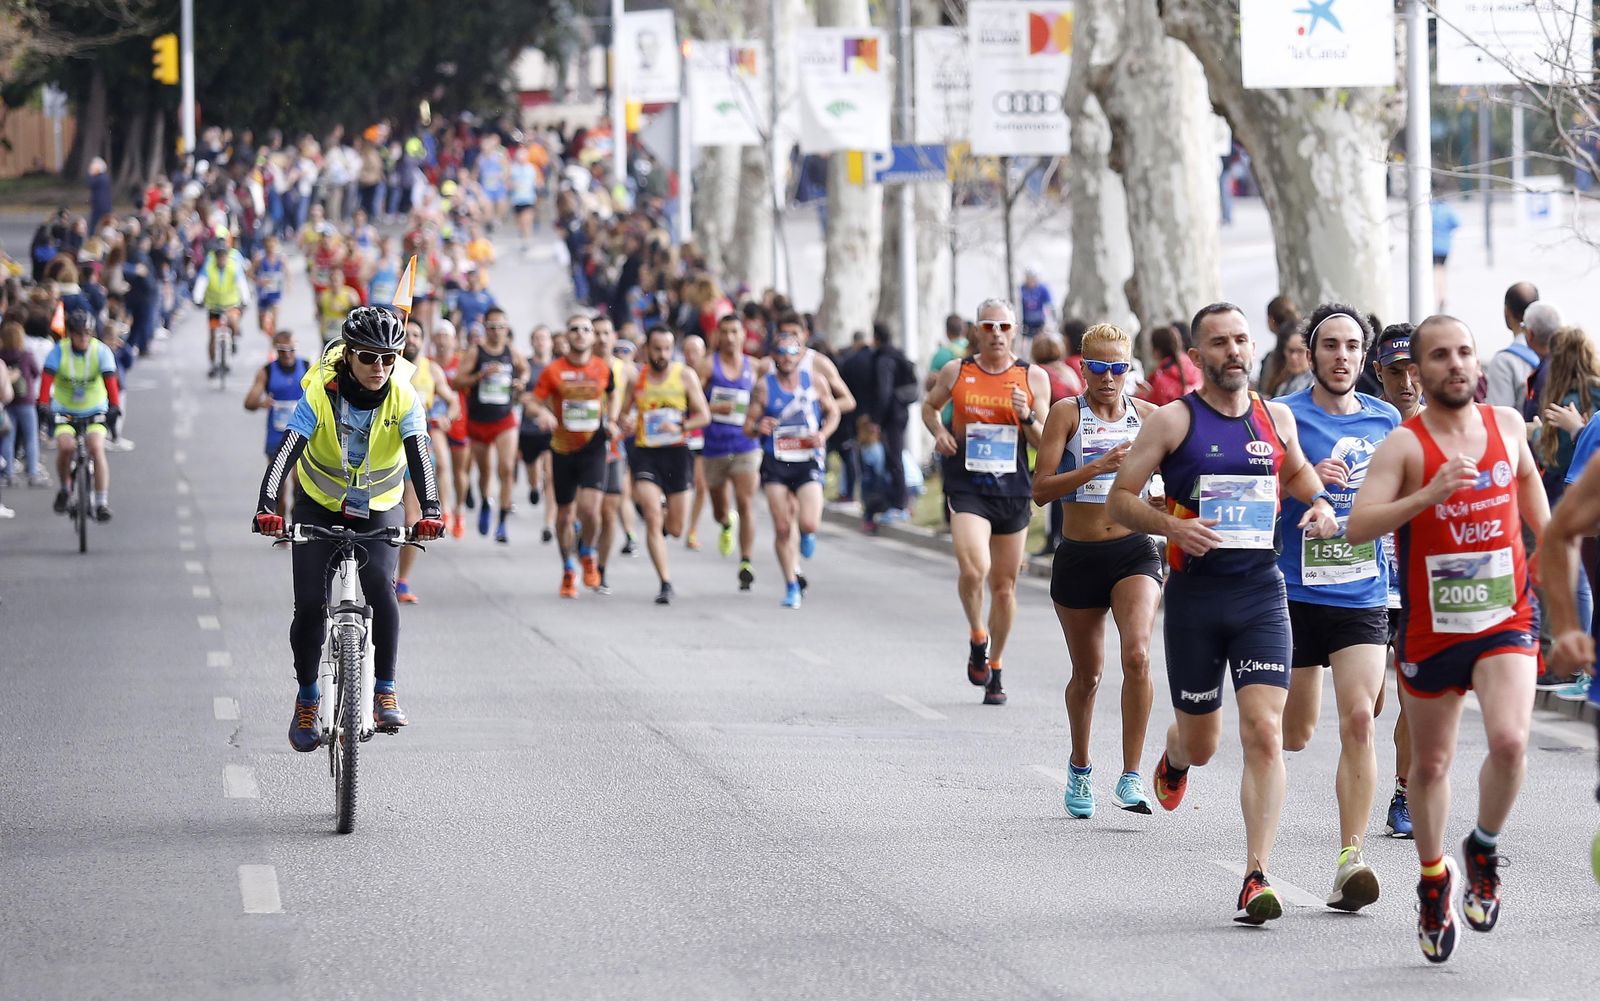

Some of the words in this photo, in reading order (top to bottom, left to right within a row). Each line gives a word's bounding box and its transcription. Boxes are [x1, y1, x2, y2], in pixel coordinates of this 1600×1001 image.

[977, 443, 992, 455] 73
[1250, 443, 1270, 453] KIA
[1248, 457, 1274, 466] VEYSER
[1214, 505, 1247, 521] 117
[1449, 519, 1504, 545] Vélez
[1311, 542, 1353, 559] 1552
[1438, 584, 1489, 604] 2006
